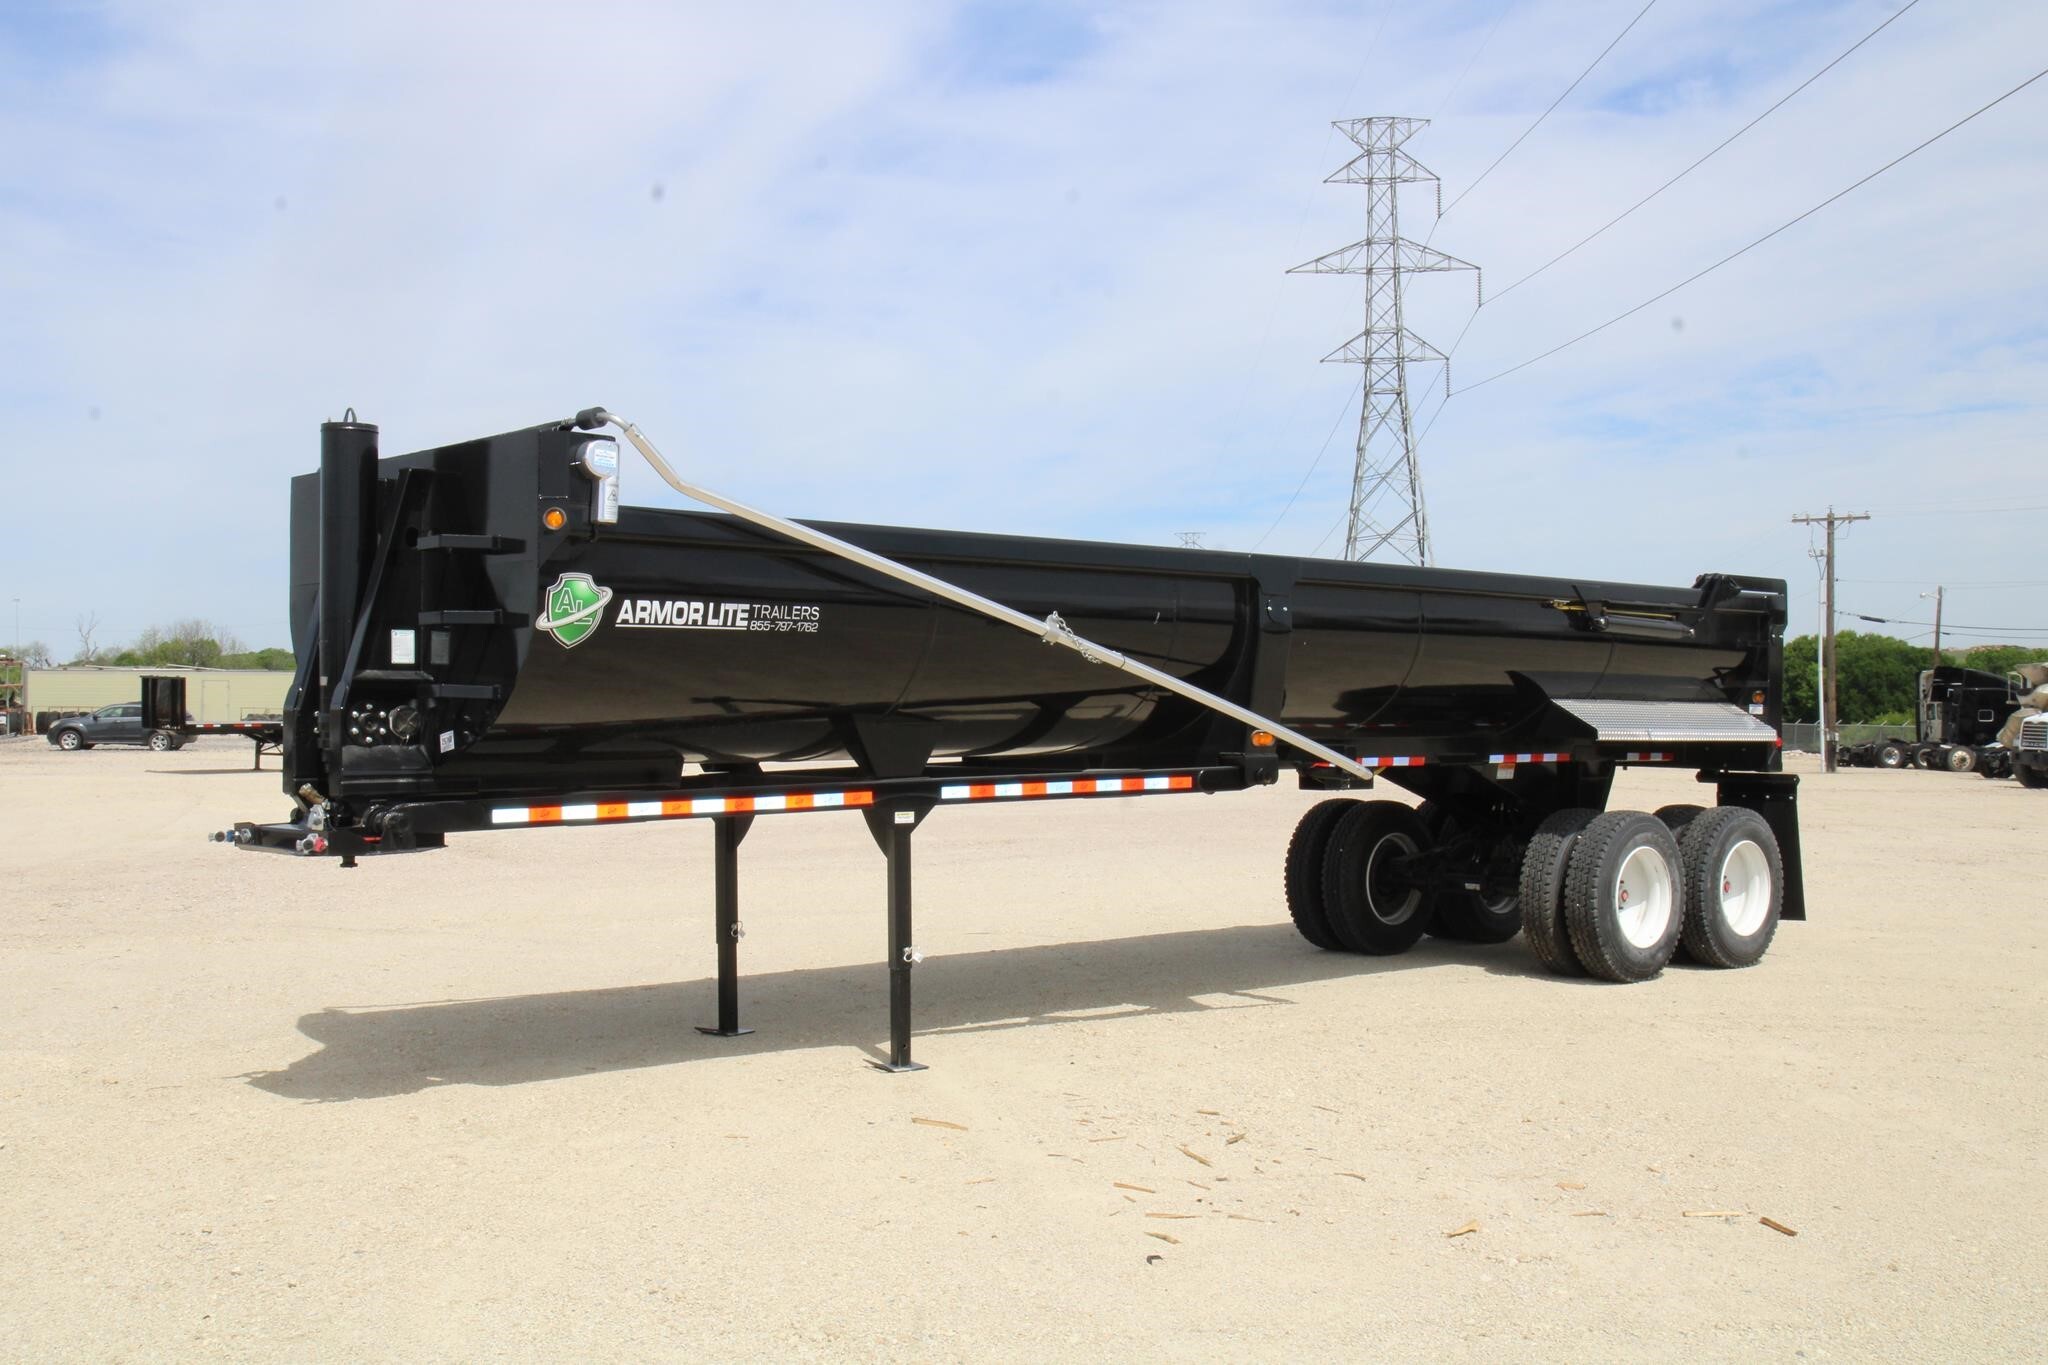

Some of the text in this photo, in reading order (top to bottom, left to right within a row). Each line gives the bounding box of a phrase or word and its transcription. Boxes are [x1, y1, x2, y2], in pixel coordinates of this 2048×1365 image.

[616, 600, 820, 626] ARMOR LITE TRAILERS
[750, 620, 819, 632] 855-797-1762
